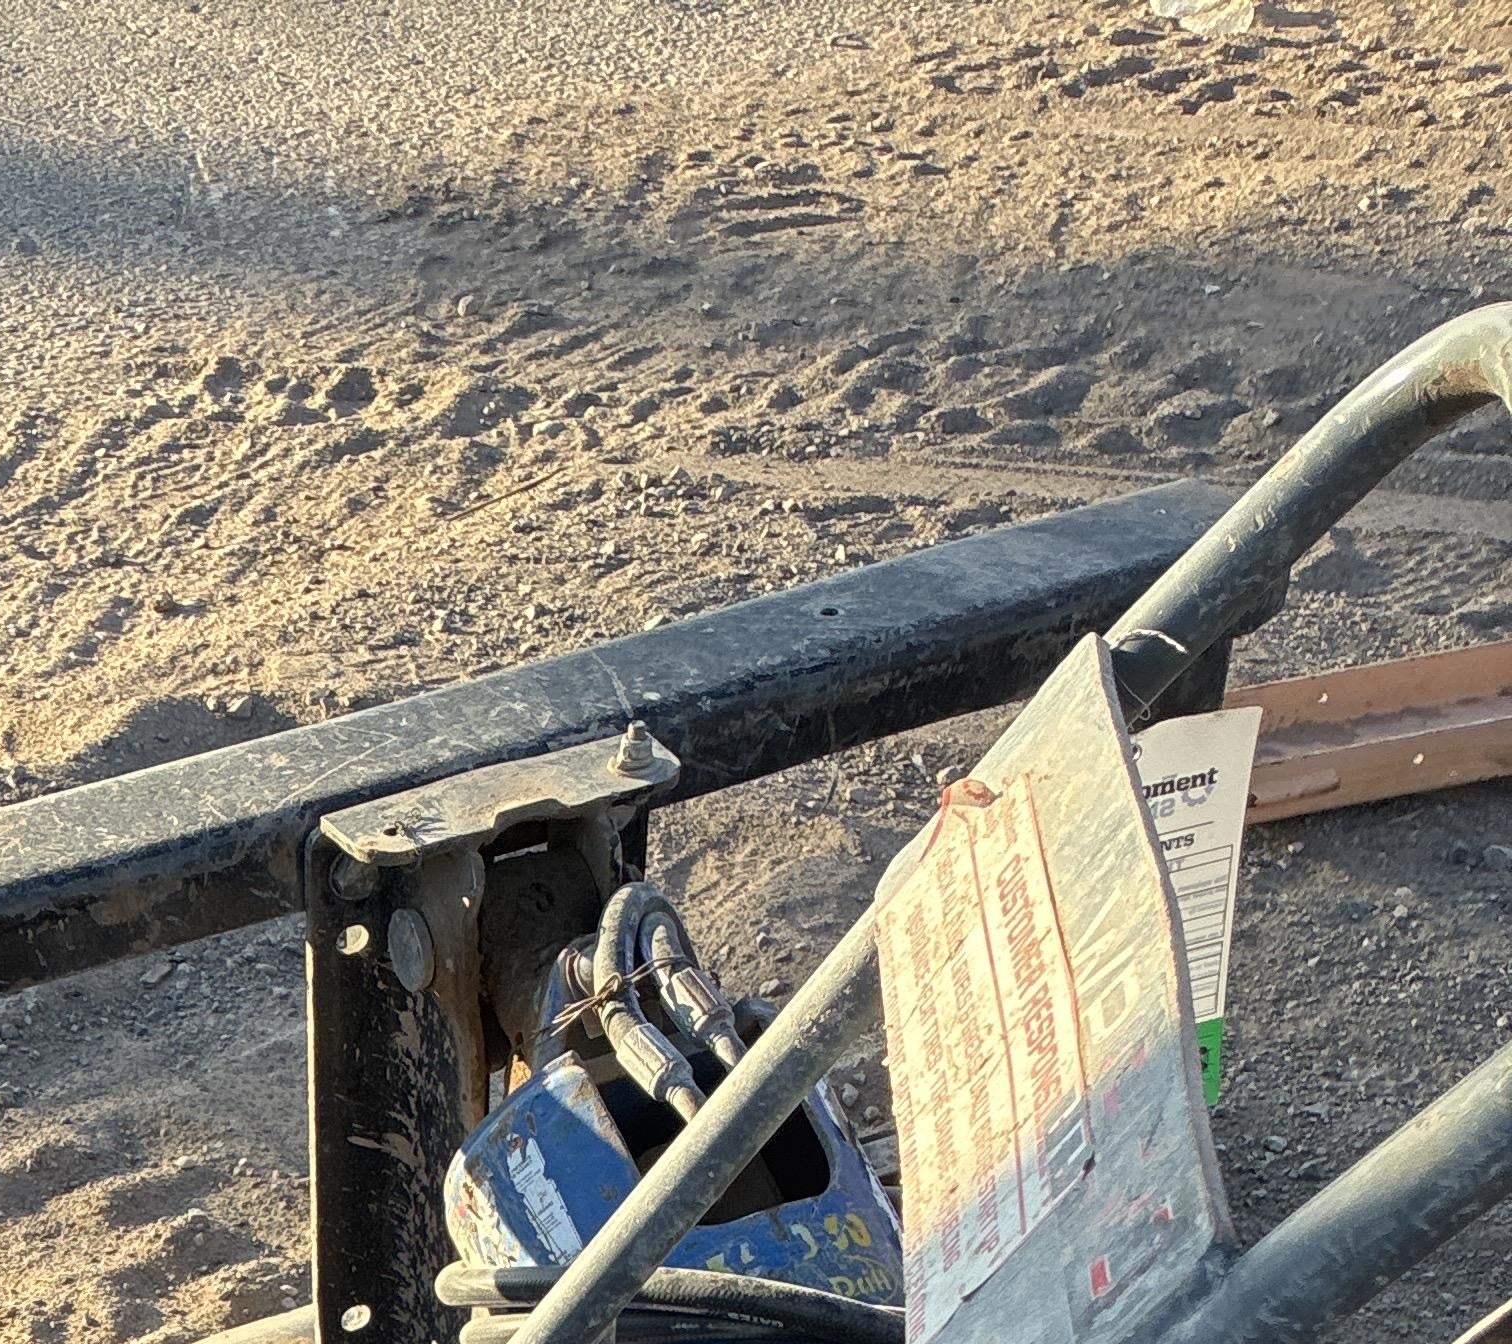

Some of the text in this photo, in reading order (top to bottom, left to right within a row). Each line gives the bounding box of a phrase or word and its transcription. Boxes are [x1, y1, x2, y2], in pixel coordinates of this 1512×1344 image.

[951, 950, 973, 1015] LEVELS
[922, 1015, 944, 1075] TIRES
[995, 856, 1065, 1208] CUSTOMER RESPONSI
[930, 1067, 950, 1119] TIRE
[968, 1072, 991, 1128] DAILY
[933, 1106, 956, 1183] DAMAGE
[976, 1173, 1000, 1235] START
[980, 1223, 1001, 1261] UP
